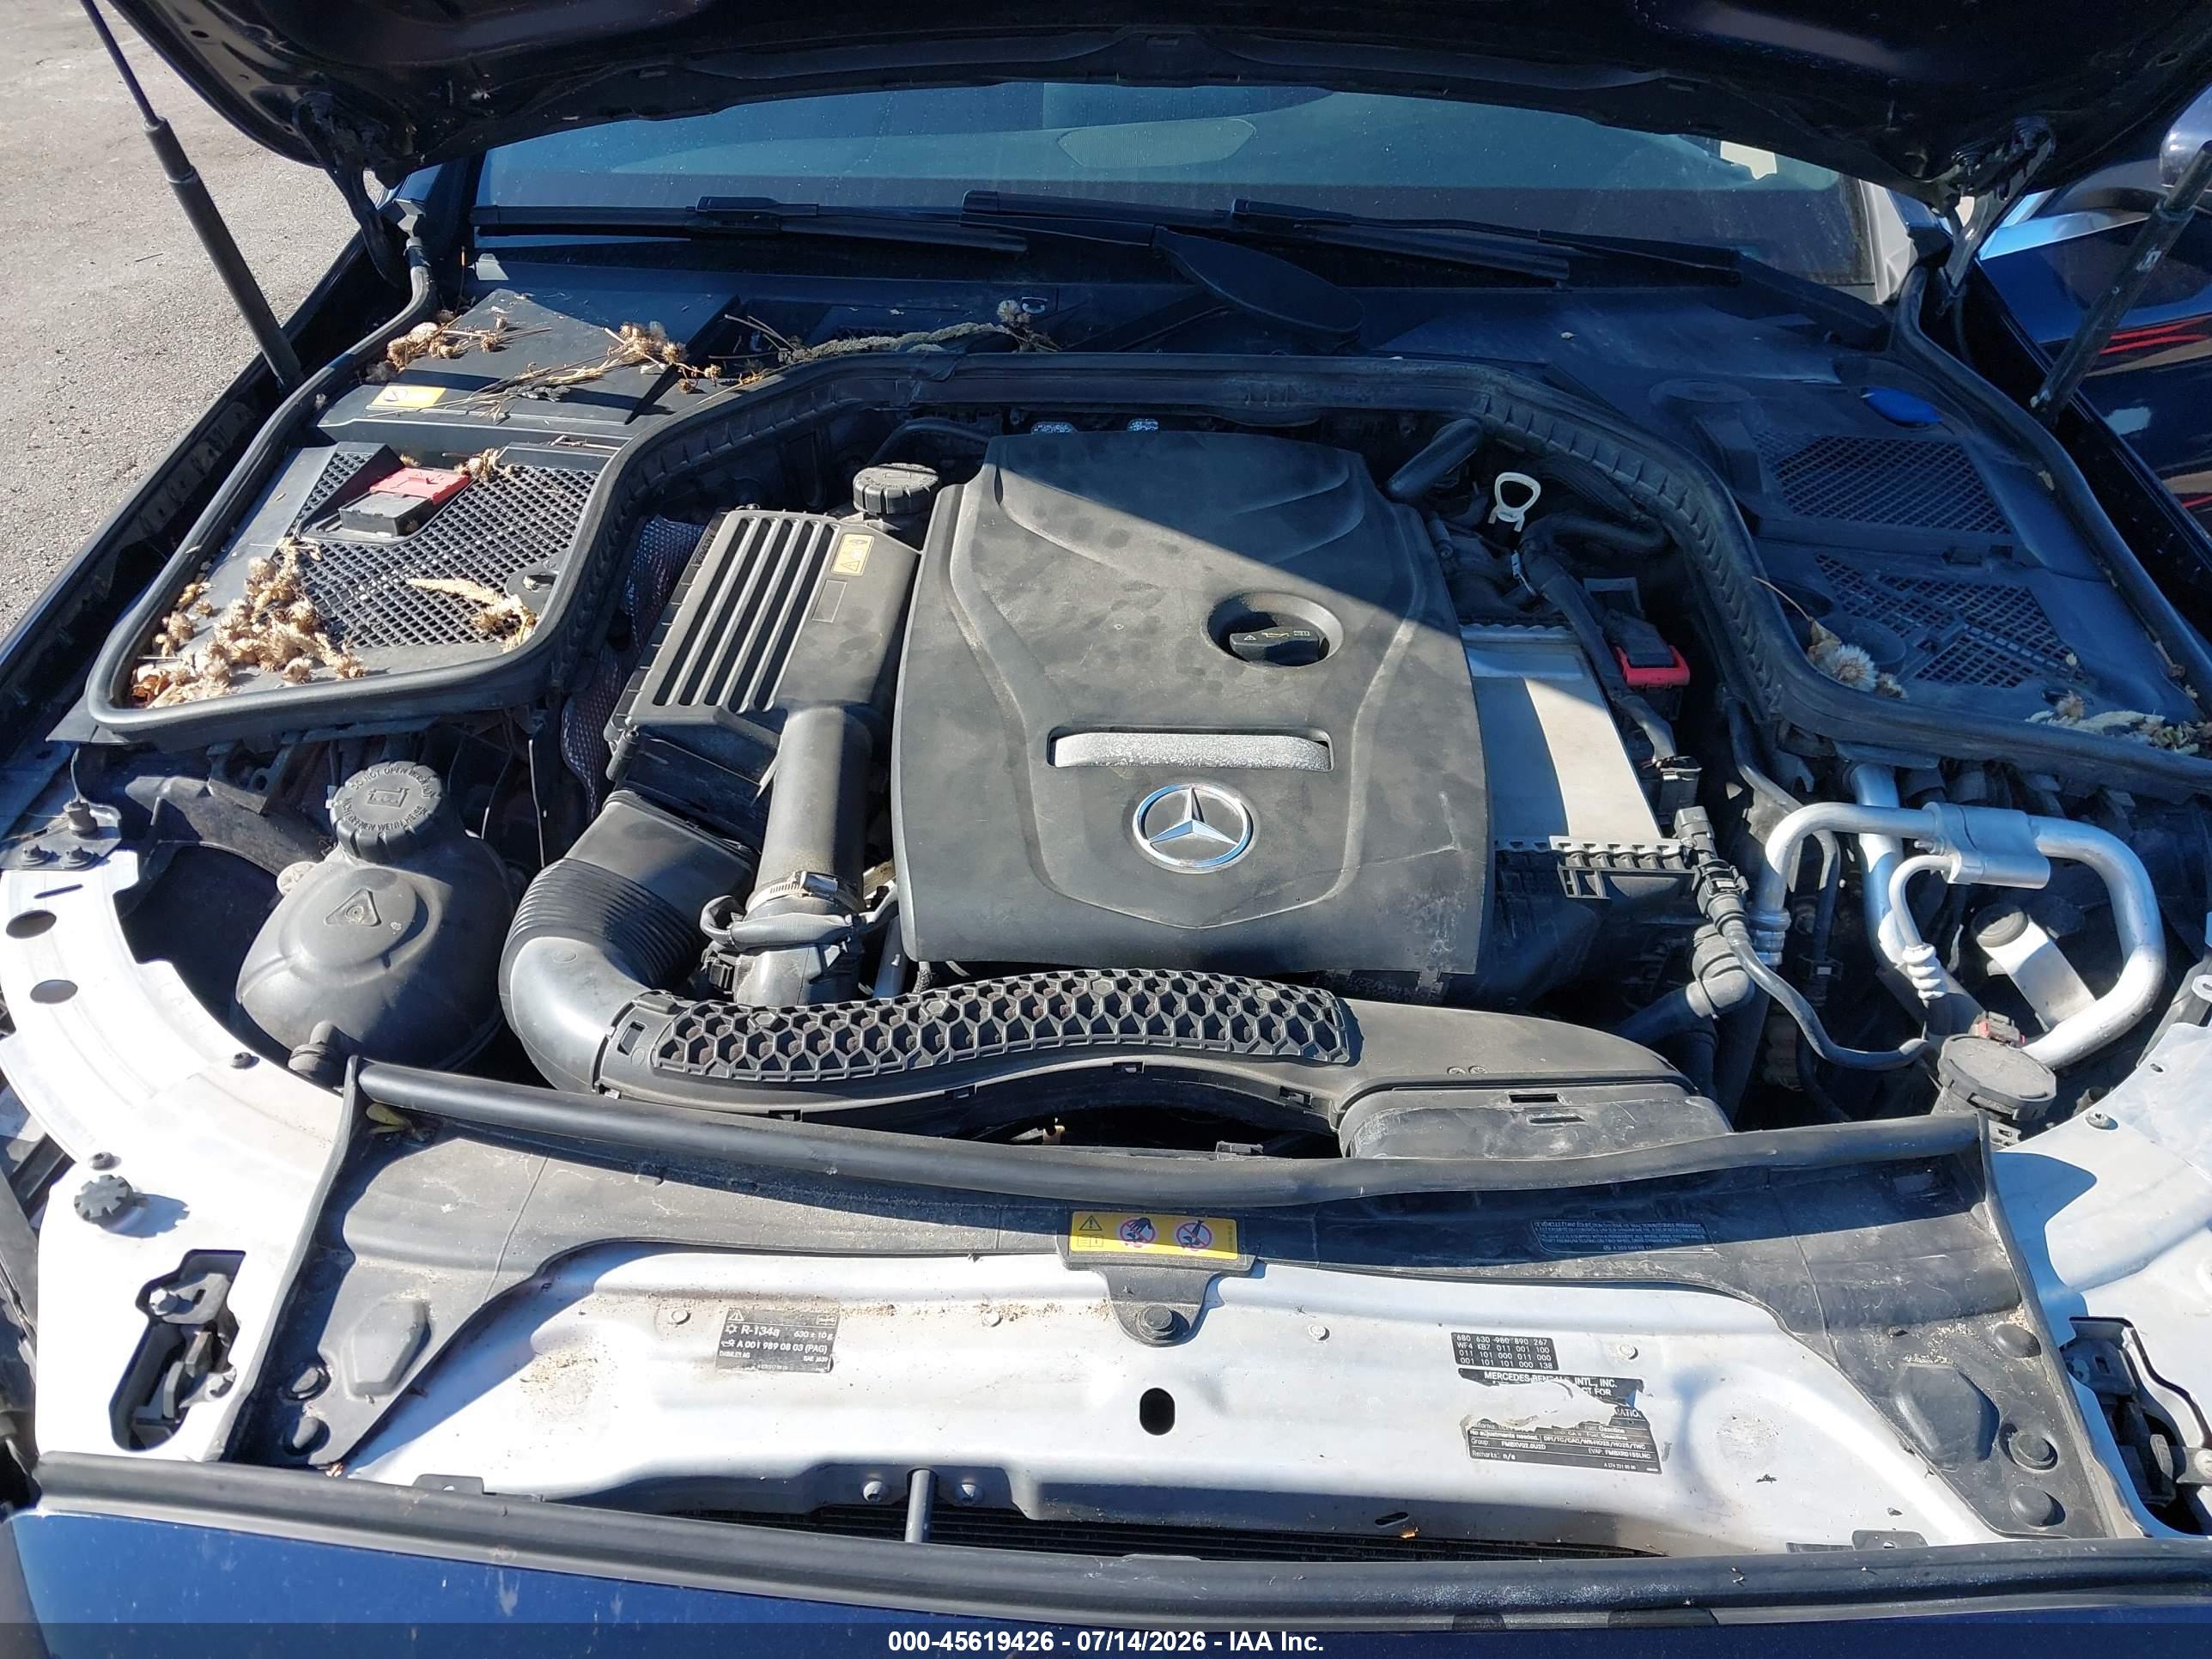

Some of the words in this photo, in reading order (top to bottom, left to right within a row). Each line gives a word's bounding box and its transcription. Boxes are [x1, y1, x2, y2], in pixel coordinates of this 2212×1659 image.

[378, 821, 404, 831] WENN
[741, 1325, 780, 1337] R-134a
[737, 1340, 744, 1348] A
[744, 1340, 760, 1349] 001
[805, 1344, 828, 1354] (PAG)
[1600, 1377, 1618, 1388] INC.
[1595, 1388, 1612, 1396] FOR
